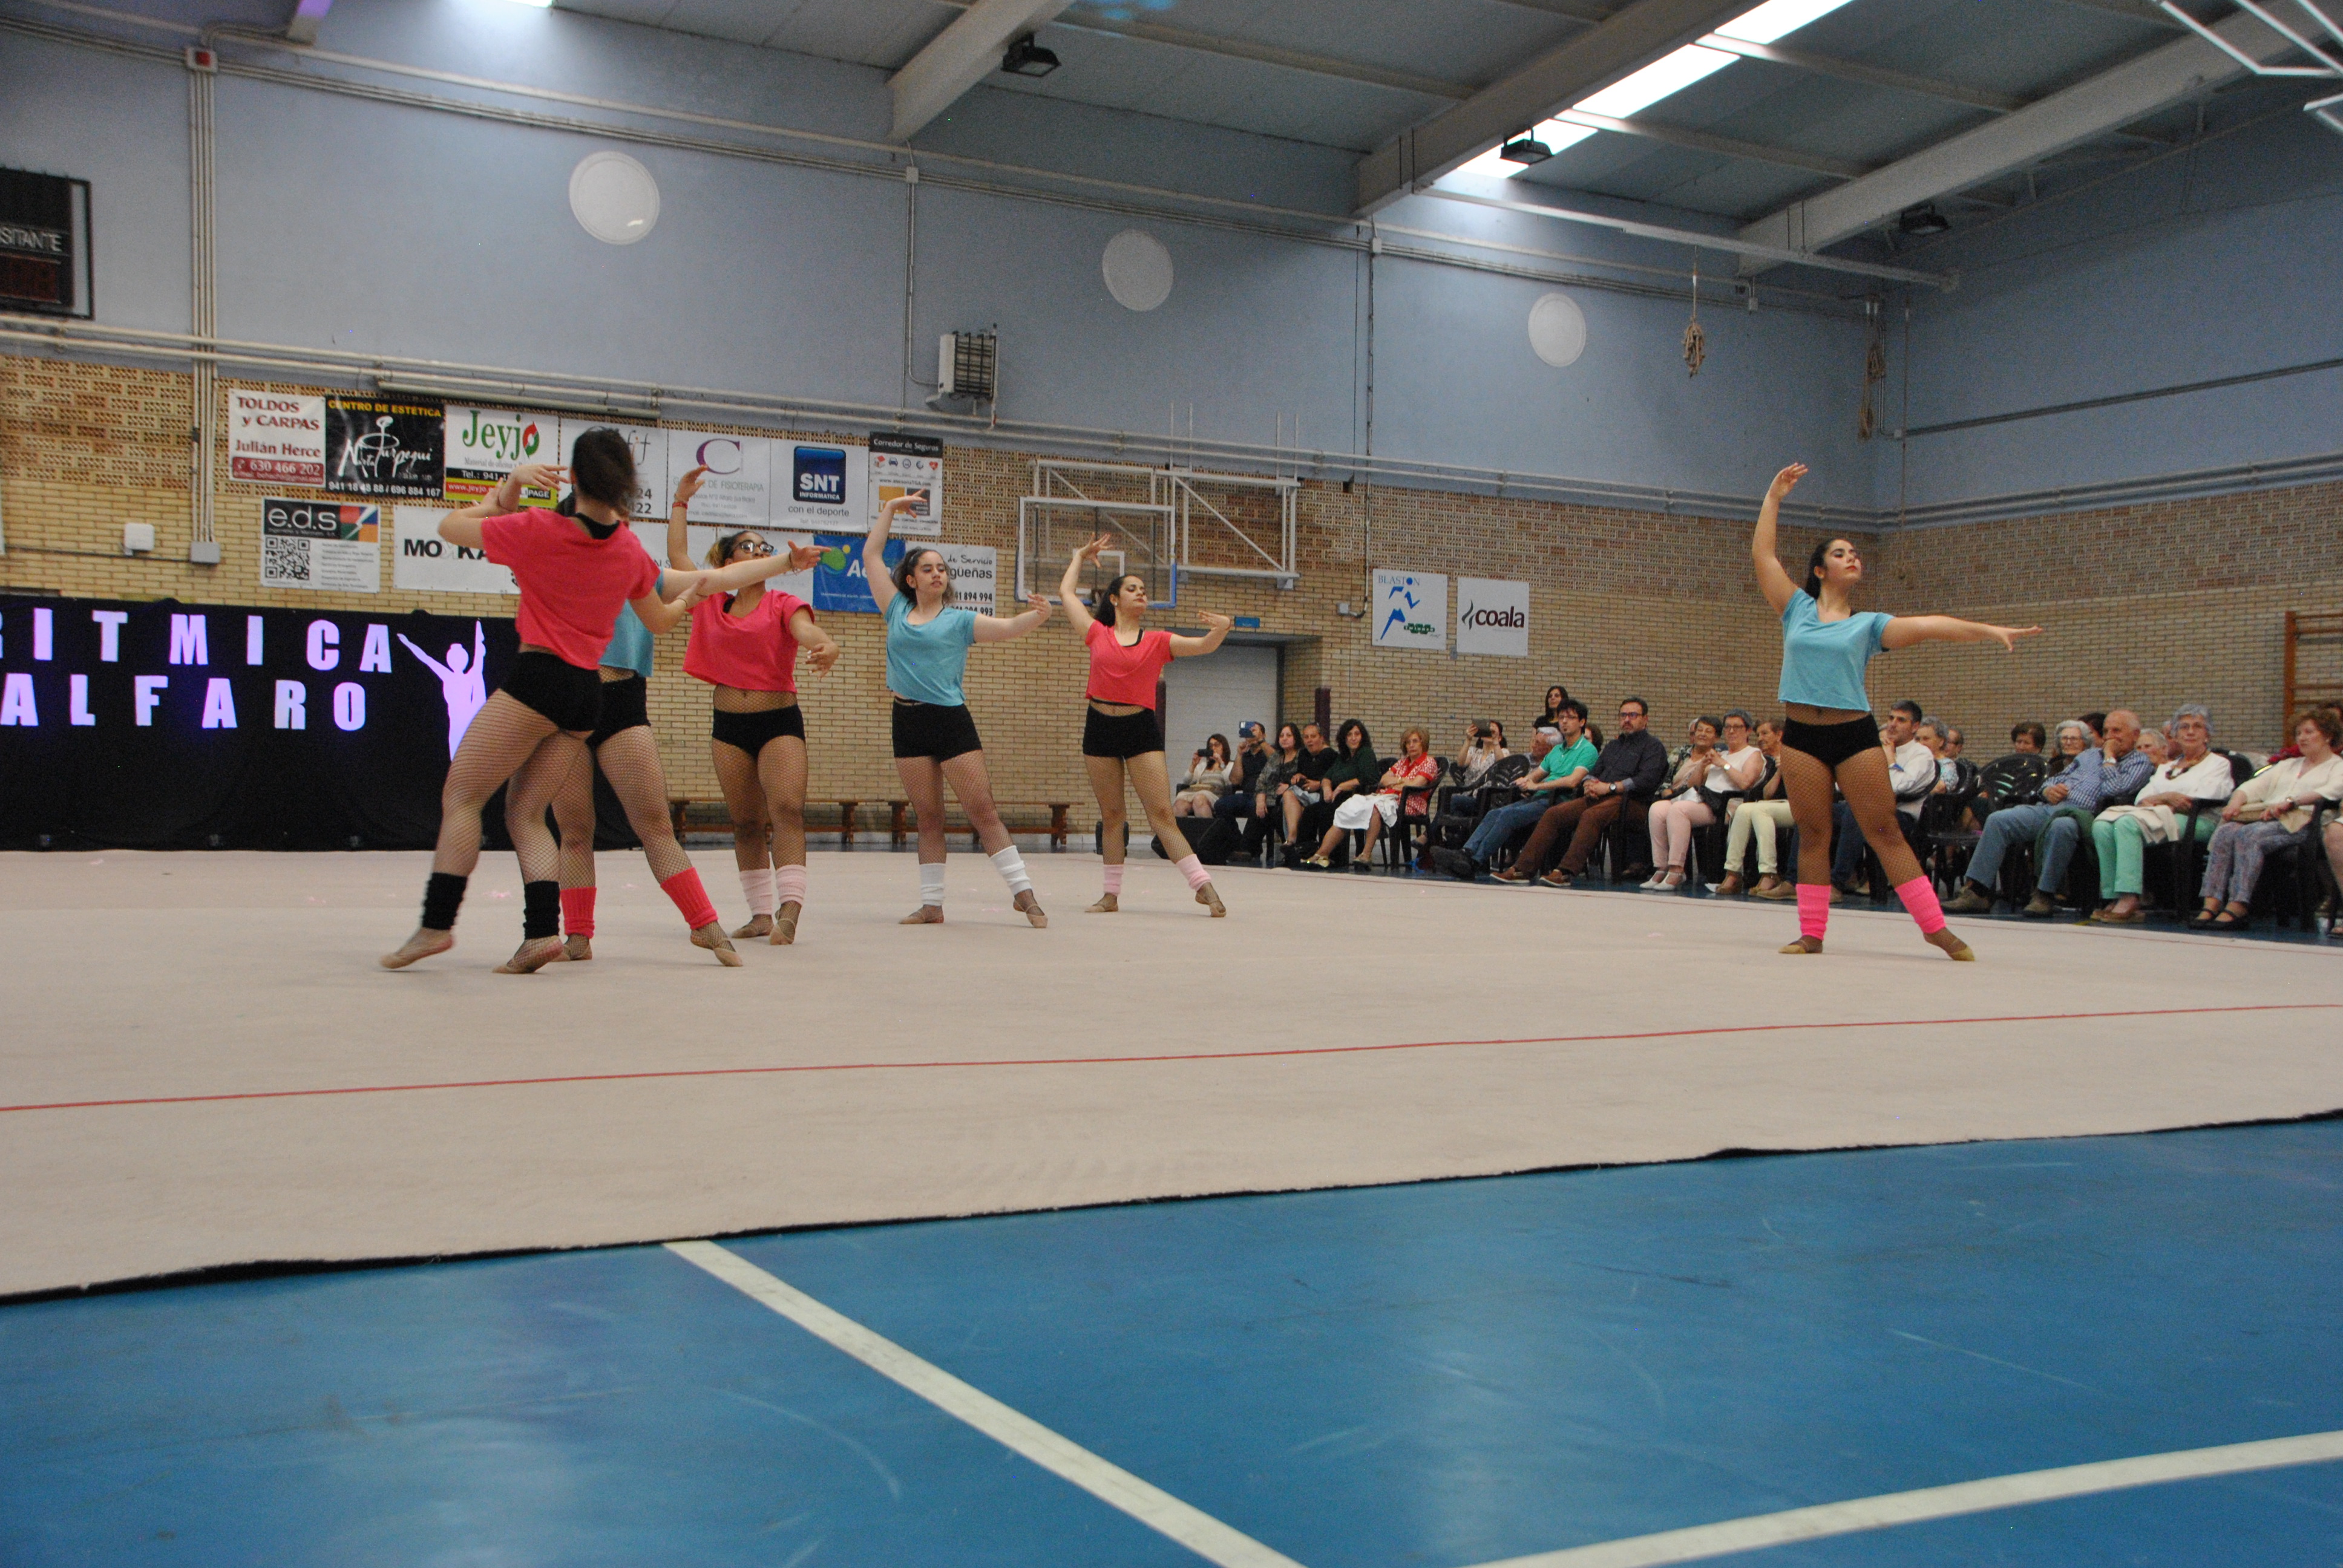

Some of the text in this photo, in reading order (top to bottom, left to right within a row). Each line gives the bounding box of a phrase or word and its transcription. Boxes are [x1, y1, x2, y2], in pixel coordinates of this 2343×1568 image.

[0, 226, 62, 252] SITANTE
[237, 397, 300, 413] TOLDOS
[328, 400, 372, 411] CENTRO
[375, 403, 389, 413] DE
[257, 415, 320, 430] CARPAS
[462, 410, 539, 460] Jeyjo
[282, 443, 321, 457] Herce
[874, 439, 902, 448] Corredor
[914, 443, 939, 451] Seguros
[250, 460, 320, 475] 630 466 202
[483, 471, 499, 480] 941
[799, 472, 840, 492] SNT
[329, 482, 345, 491] 941
[391, 485, 407, 495] 696
[427, 488, 441, 497] 167
[709, 480, 717, 488] DE
[721, 481, 764, 492] FISIOTERAPIA
[817, 507, 850, 517] deporte
[948, 554, 992, 564] de Servicio
[950, 567, 992, 580] güeñas
[964, 592, 977, 601] 894
[979, 592, 992, 602] 994
[1475, 606, 1525, 628] coala
[0, 607, 392, 673] ITMICA
[0, 673, 366, 731] ALFARO
